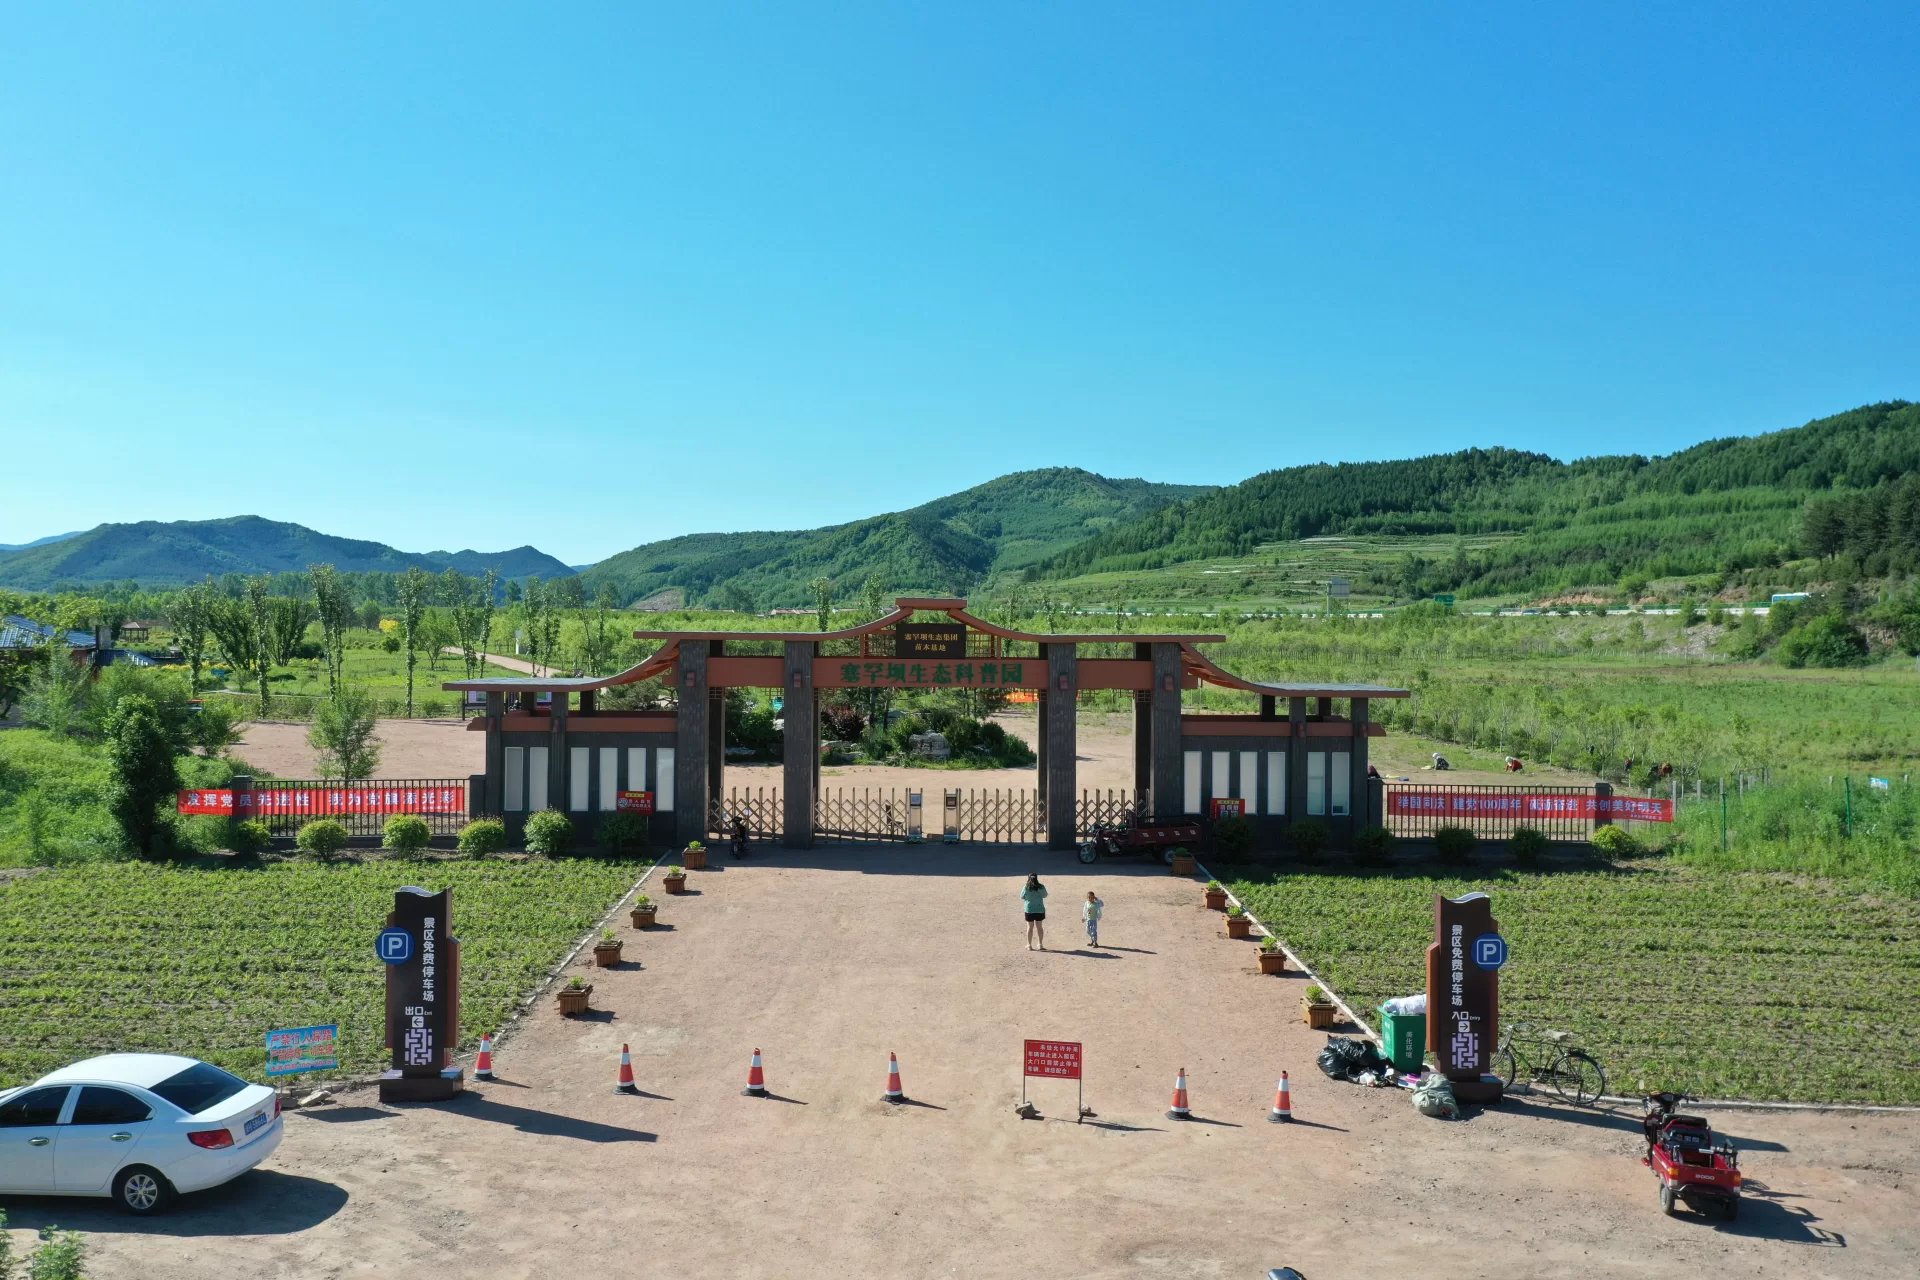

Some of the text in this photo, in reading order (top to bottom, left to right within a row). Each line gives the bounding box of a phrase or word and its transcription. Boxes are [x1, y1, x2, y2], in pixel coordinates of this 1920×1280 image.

[904, 633, 958, 641] 塞罕坝生态集团
[915, 643, 947, 651] 苗木基地
[840, 662, 1023, 684] 塞罕坝生态科普园
[187, 791, 454, 807] 发挥党员先进性 我为党旗添光彩
[1398, 796, 1662, 814] 举国同庆 建党100周年 砥砺奋进 共创美好明天
[388, 937, 403, 956] P
[1483, 943, 1497, 962] P
[422, 917, 435, 1002] 景区免费停车场
[1451, 924, 1464, 1006] 景区免费停车场
[405, 1006, 423, 1015] 出口
[1451, 1010, 1468, 1020] 入口
[1405, 1031, 1413, 1059] 美化环境
